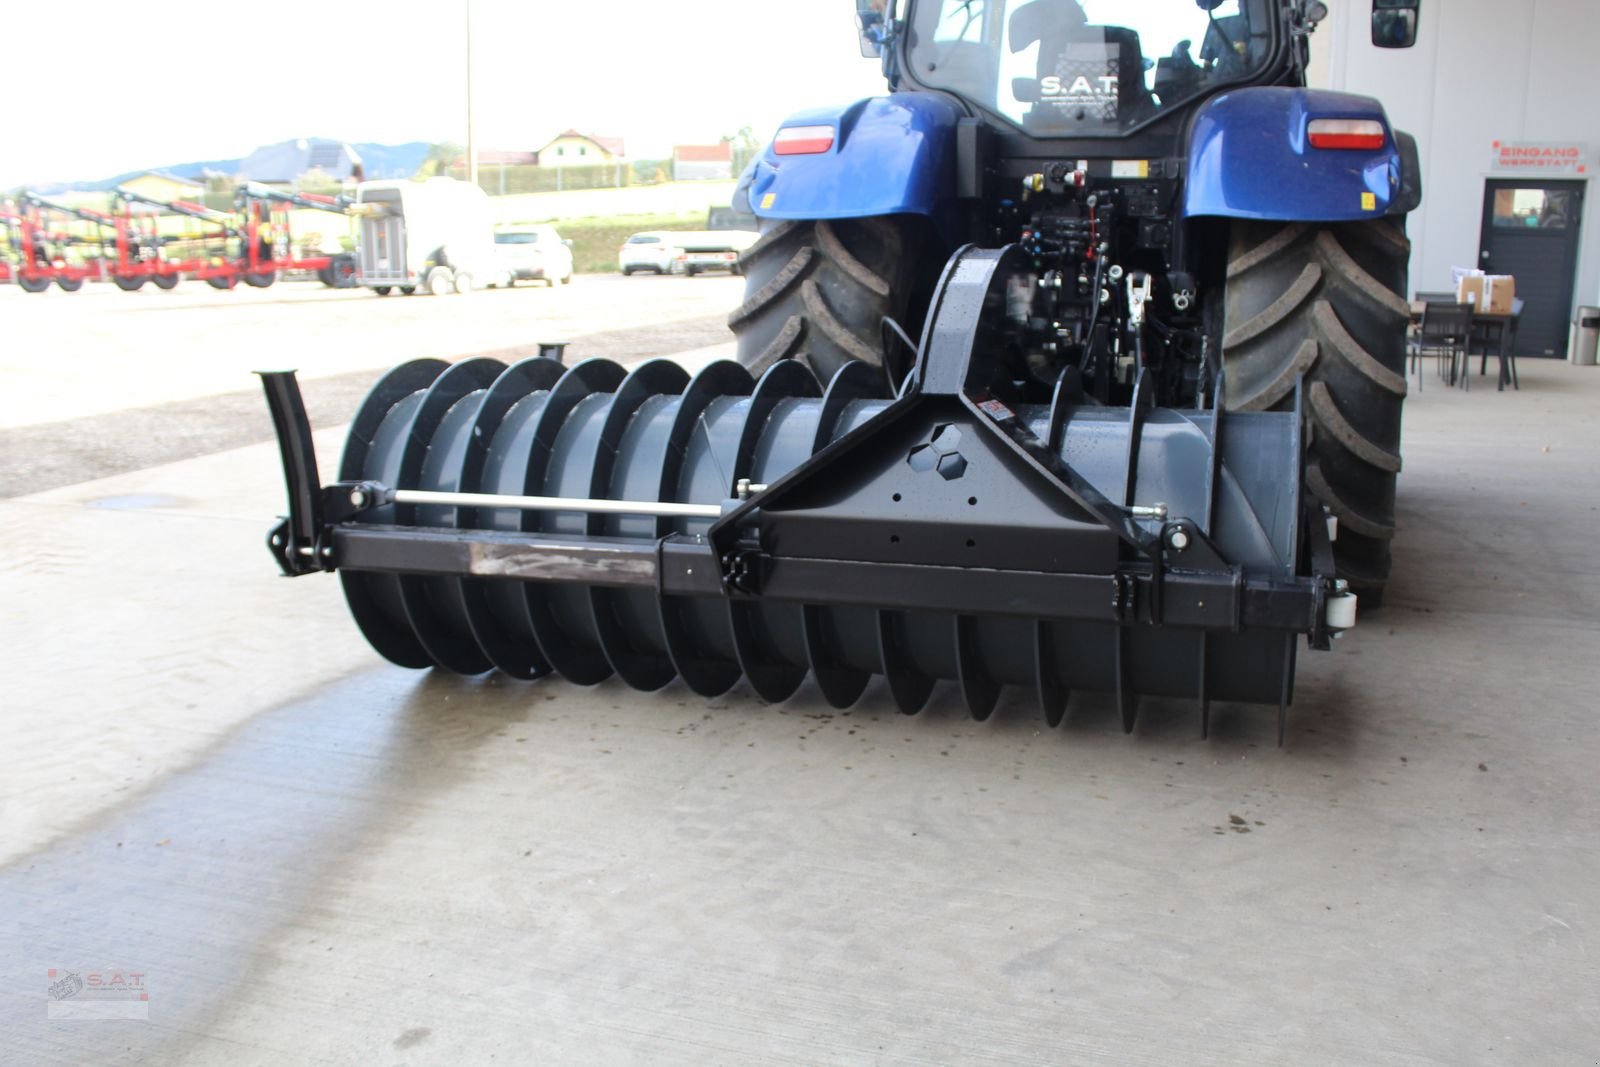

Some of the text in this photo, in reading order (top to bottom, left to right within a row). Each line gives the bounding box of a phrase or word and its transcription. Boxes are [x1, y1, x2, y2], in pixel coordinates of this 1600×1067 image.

[1041, 76, 1119, 95] S.A.T.
[1501, 147, 1579, 157] EINGANG
[1499, 159, 1577, 167] WERKSTATT
